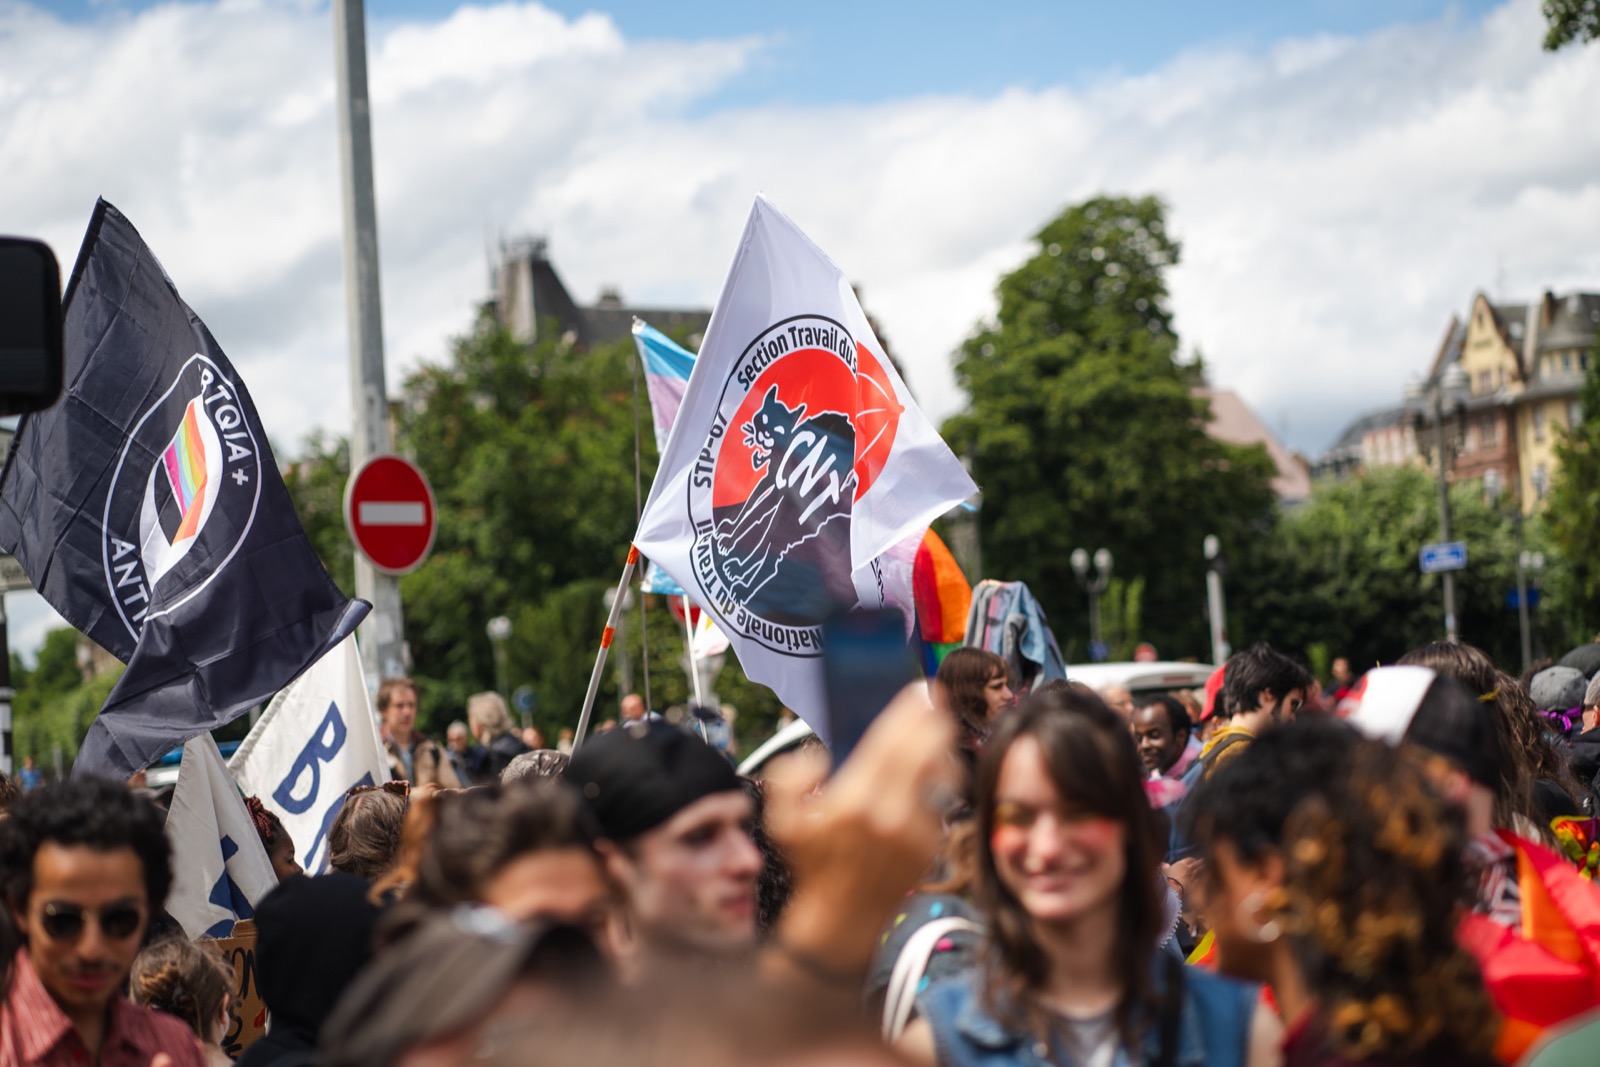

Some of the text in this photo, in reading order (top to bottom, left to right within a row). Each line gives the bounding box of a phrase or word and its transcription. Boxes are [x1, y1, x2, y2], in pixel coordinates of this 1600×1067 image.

[737, 334, 789, 392] Section
[788, 325, 838, 353] Travail
[839, 337, 853, 367] du
[111, 537, 150, 633] ANTI
[715, 586, 736, 616] du
[736, 608, 825, 652] Nationale
